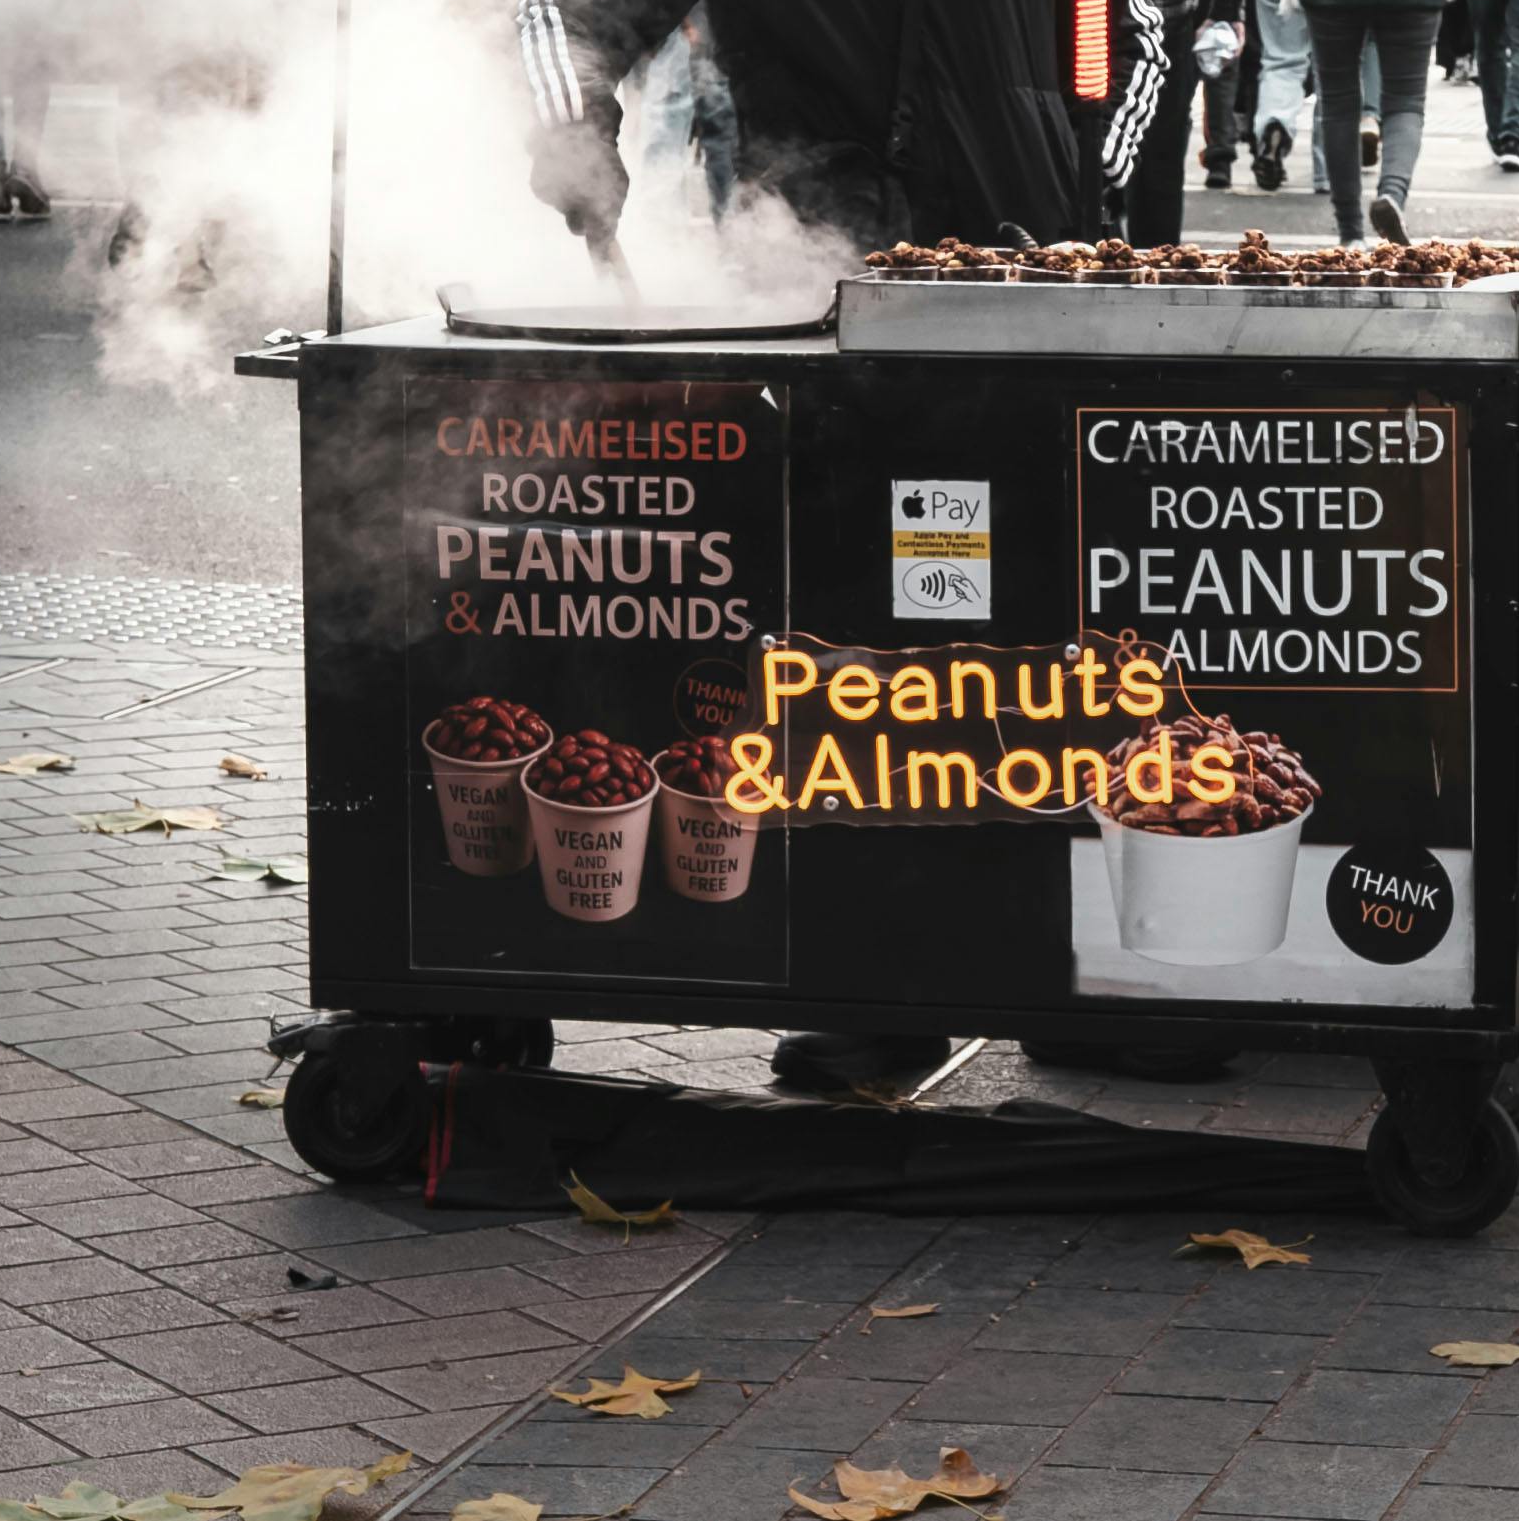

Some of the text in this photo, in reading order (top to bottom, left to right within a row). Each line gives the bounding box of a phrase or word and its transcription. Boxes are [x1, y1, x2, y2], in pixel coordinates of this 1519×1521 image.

[437, 416, 747, 461] CARAMELISED
[1087, 420, 1445, 465] CARAMELISED
[482, 472, 696, 516] ROASTED
[932, 491, 980, 528] Pay
[1150, 486, 1384, 530] ROASTED
[437, 525, 734, 586] PEANUTS
[1090, 547, 1449, 617] PEANUTS
[445, 591, 749, 641] & ALMONDS
[1162, 629, 1423, 674] ALMONDS
[687, 678, 747, 708] THANK
[763, 647, 1165, 726] Peanuts
[695, 703, 735, 726] YOU
[448, 783, 508, 805] VEGAN
[554, 829, 623, 851] VEGAN
[677, 816, 741, 839] VEGAN
[575, 855, 607, 869] AND
[677, 855, 738, 873] GLUTEN
[694, 842, 725, 856] AND
[556, 869, 623, 889] GLUTEN
[688, 876, 728, 892] FREE
[1350, 865, 1439, 911] THANK
[569, 892, 612, 909] FREE
[1361, 900, 1414, 933] YOU
